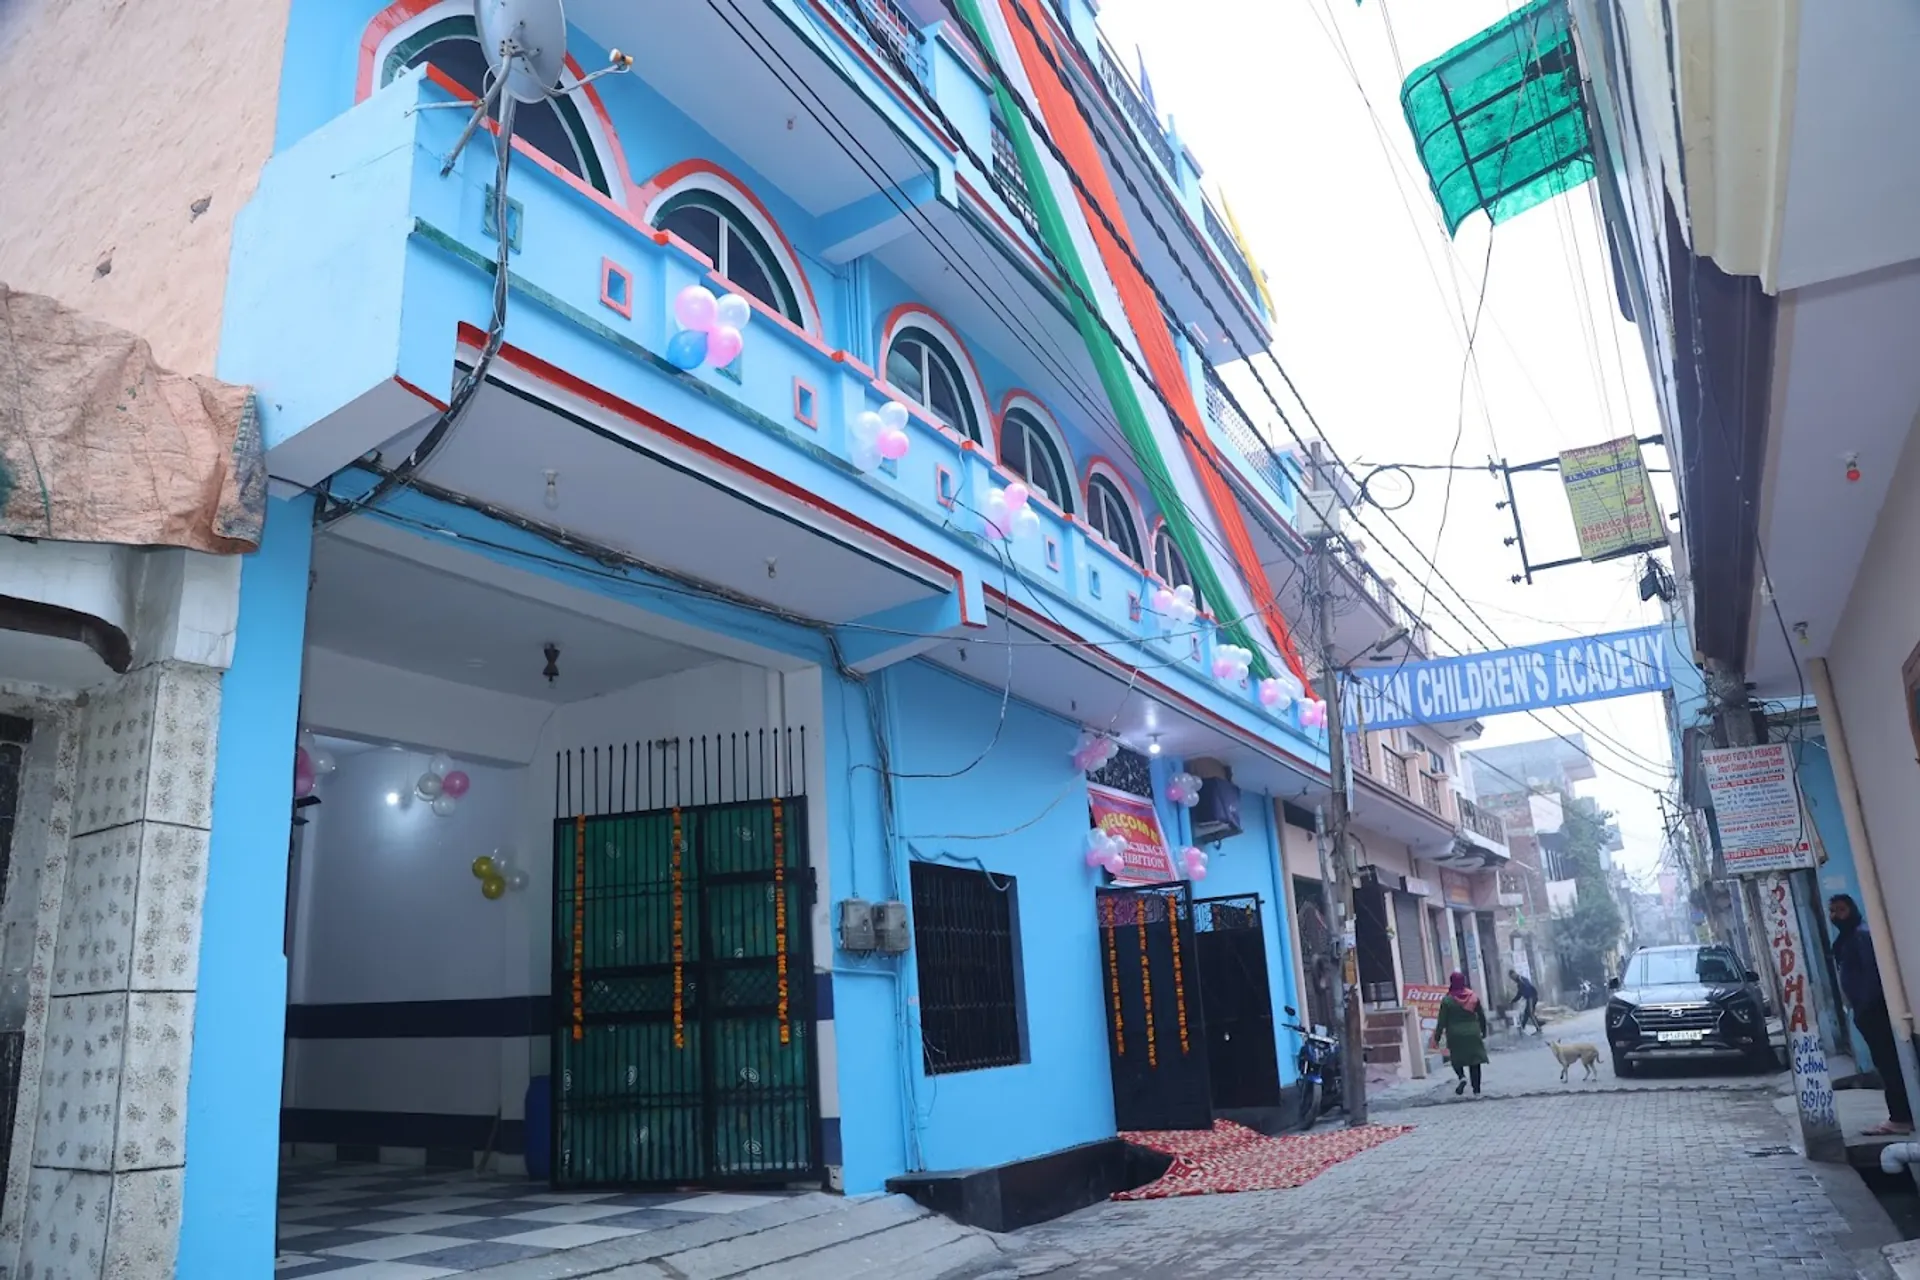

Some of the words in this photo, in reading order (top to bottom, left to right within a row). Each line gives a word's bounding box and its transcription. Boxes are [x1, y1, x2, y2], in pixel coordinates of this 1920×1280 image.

[1416, 651, 1550, 717] CHILDREN'S
[1553, 633, 1668, 699] ACADEMY
[1101, 813, 1159, 845] WELCOME
